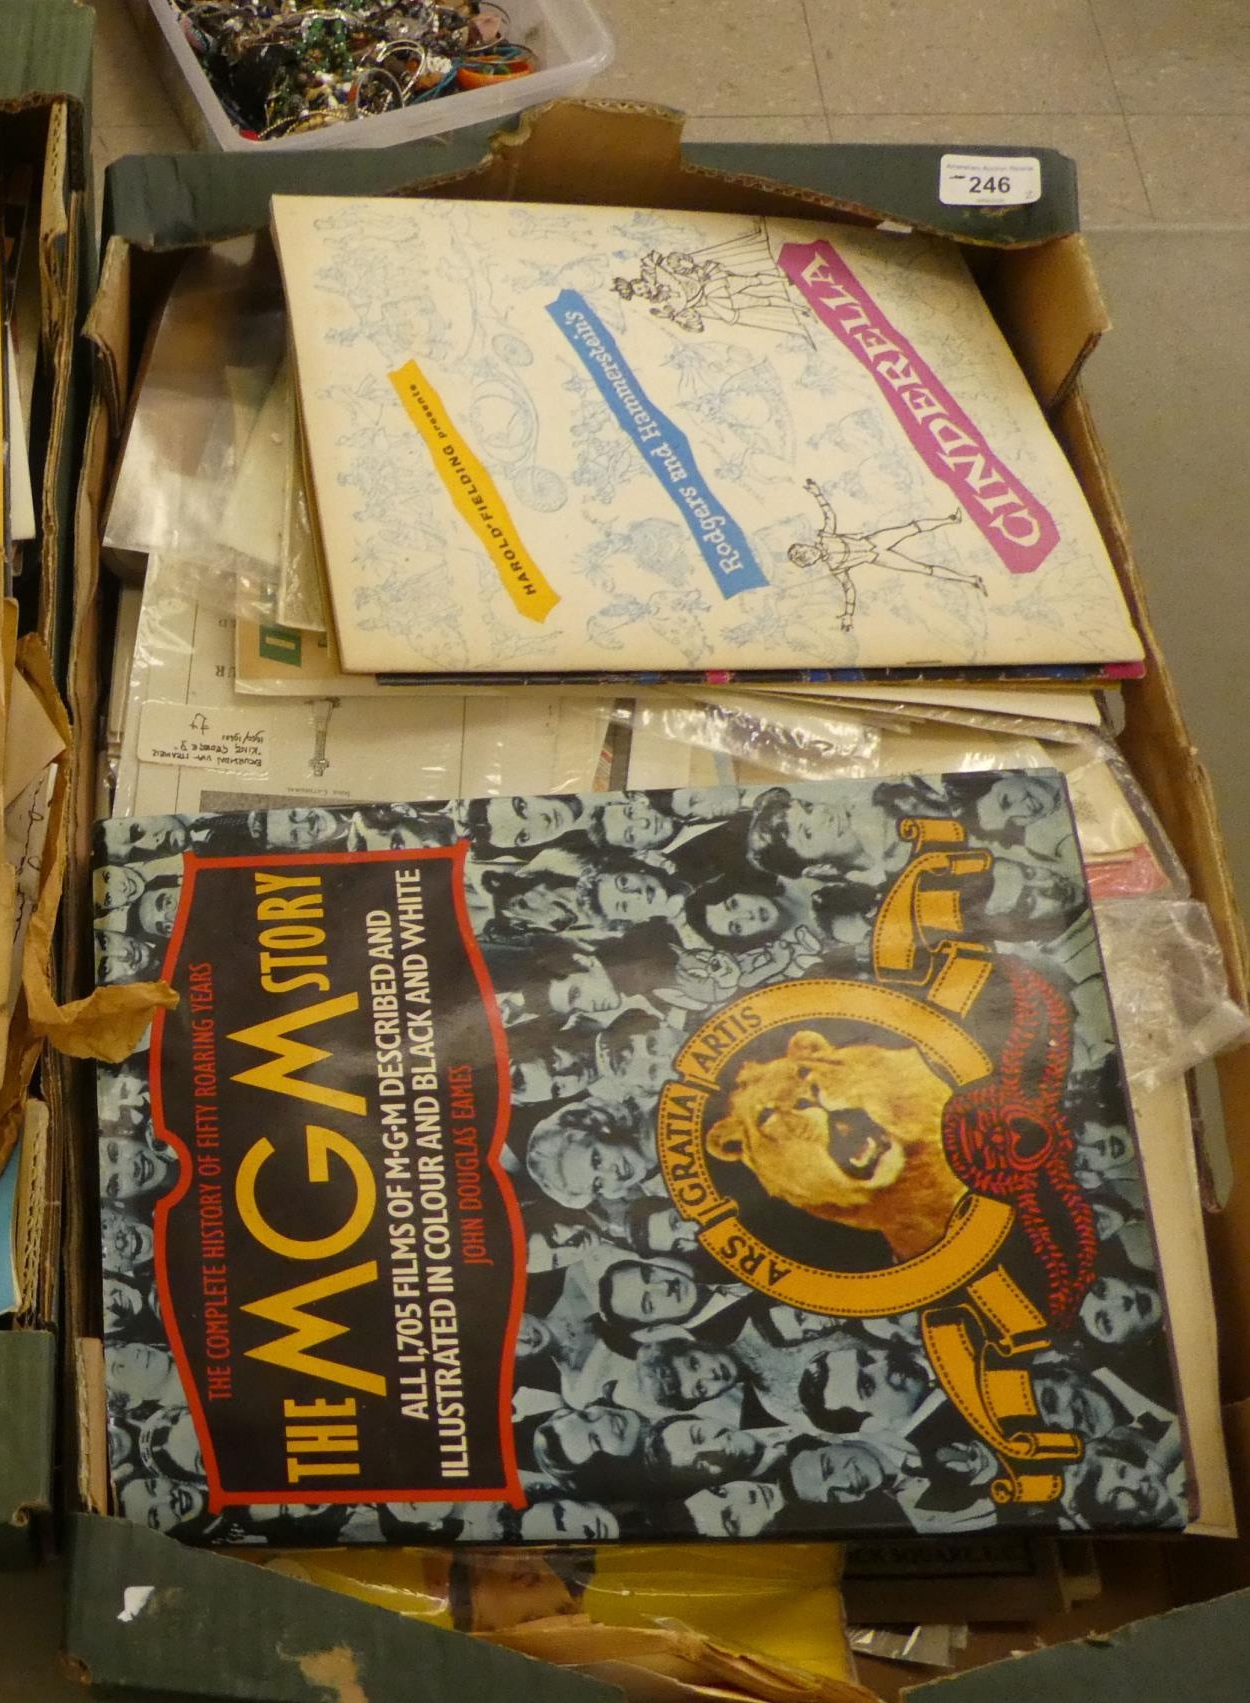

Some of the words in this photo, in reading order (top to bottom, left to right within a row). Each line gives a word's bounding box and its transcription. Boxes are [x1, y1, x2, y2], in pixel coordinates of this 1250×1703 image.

[969, 176, 1010, 193] 246
[565, 310, 661, 442] Hammerstein's
[801, 252, 1041, 548] CINDERELLA
[409, 384, 447, 438] presents
[442, 445, 493, 521] FIELDING
[650, 441, 687, 482] and
[490, 527, 538, 596] HAROLD
[679, 487, 744, 574] Rodgers
[254, 872, 331, 993] STORY
[365, 909, 394, 960] AND
[394, 868, 430, 950] WHITE
[189, 961, 214, 1013] YEARS
[402, 953, 432, 1005] AND
[191, 1017, 218, 1097] ROARING
[370, 963, 406, 1098] DESCRIBED
[406, 1008, 438, 1091] BLACK
[692, 1006, 762, 1074] ARTIS
[413, 1094, 444, 1150] AND
[447, 1063, 476, 1119] EAMES
[195, 1104, 220, 1149] FIFTY
[666, 1094, 707, 1207] GRATIA
[197, 1153, 221, 1176] OF
[452, 1125, 484, 1211] DOUGLAS
[199, 1183, 226, 1259] HISTORY
[386, 1184, 414, 1218] OF
[417, 1155, 453, 1263] COLOUR
[388, 1224, 421, 1298] FILMS
[460, 1216, 494, 1267] JOHN
[721, 1234, 792, 1287] ARS
[202, 1264, 231, 1361] COMPLETE
[426, 1266, 454, 1293] IN
[394, 1303, 430, 1363] 1,705
[208, 1365, 233, 1401] THE
[399, 1368, 430, 1420] ALL
[429, 1297, 470, 1478] ILLUSTRATED
[283, 1397, 360, 1483] THE
